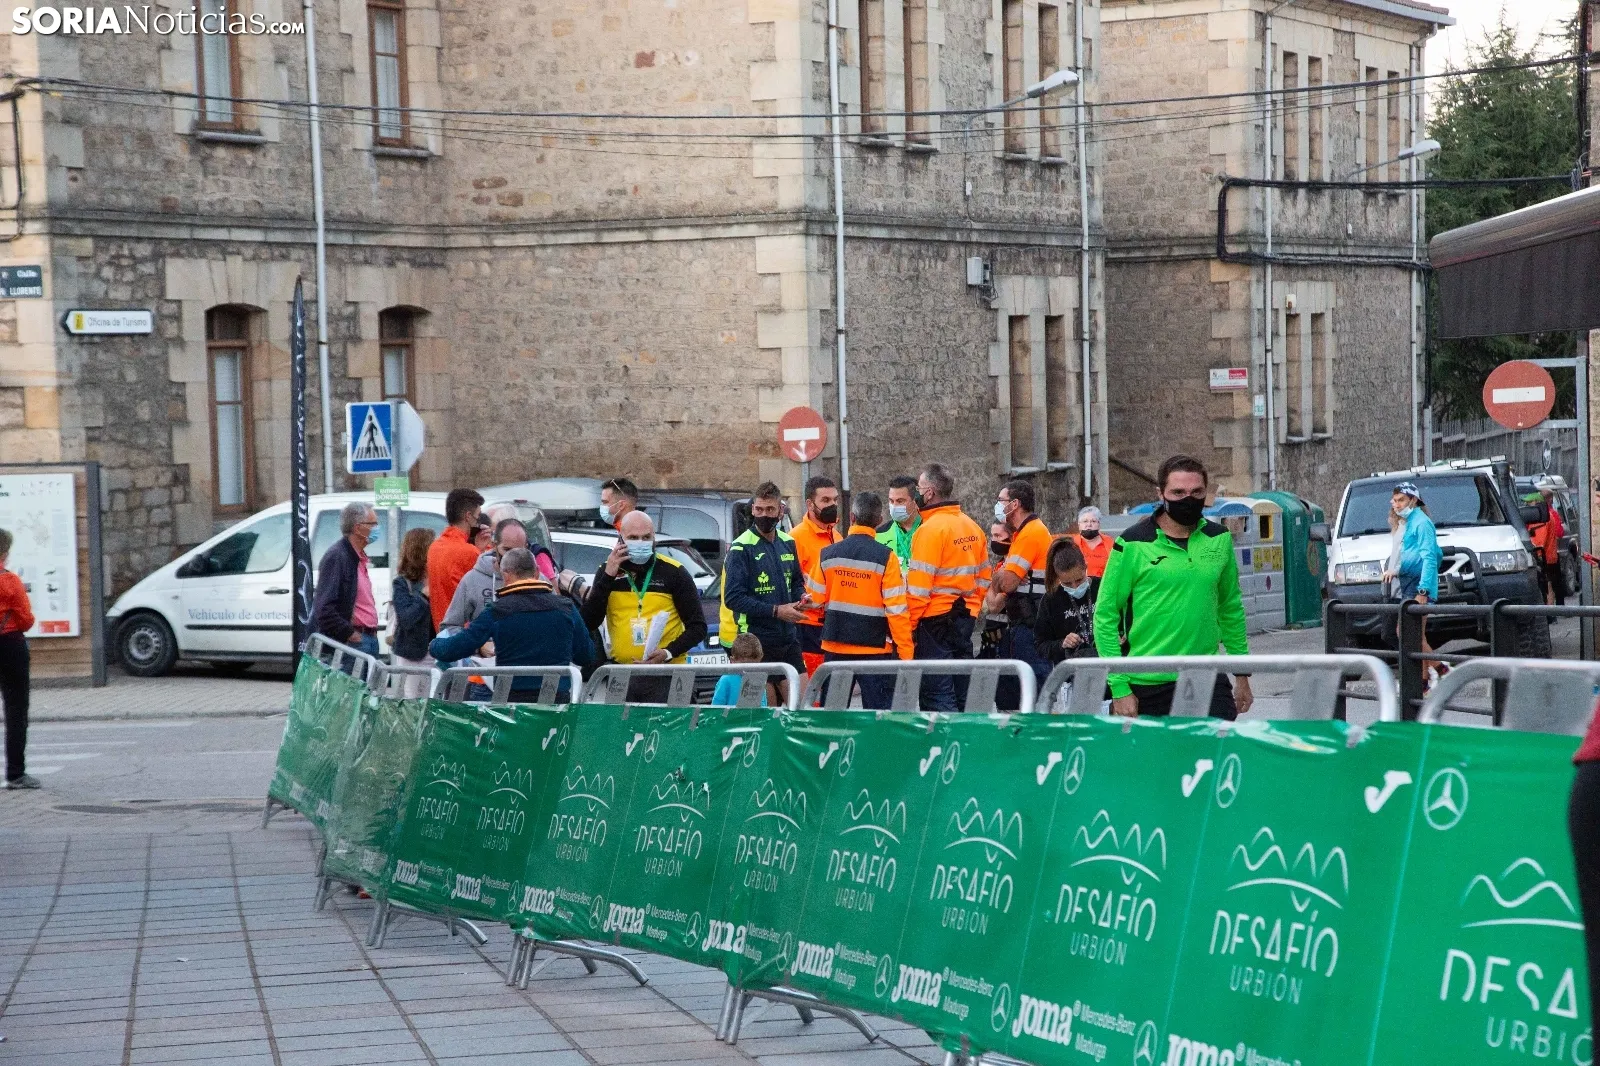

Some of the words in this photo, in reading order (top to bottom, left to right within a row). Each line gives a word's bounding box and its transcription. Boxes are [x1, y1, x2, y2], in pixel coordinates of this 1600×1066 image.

[87, 316, 110, 327] Oficina
[112, 317, 120, 327] de
[122, 316, 147, 328] Turismo
[840, 580, 858, 589] CIVIL
[238, 608, 252, 621] de
[547, 809, 608, 848] DESAFÍO
[635, 820, 703, 860] DESAFÍO
[734, 831, 798, 875] DESAFÍO
[826, 846, 898, 893] DESAFÍO
[392, 859, 419, 885] Joma
[450, 873, 482, 902] Joma
[930, 860, 1014, 914] DESAFÍO
[519, 885, 555, 915] Joma
[834, 887, 875, 913] URBIÓN
[1055, 882, 1157, 942] DESAFÍO
[603, 902, 645, 935] Joma
[650, 905, 688, 923] Mercedes-Benz
[748, 925, 781, 944] Mercedes-Benz
[941, 907, 988, 936] URBIÓN
[790, 941, 834, 979] Joma
[839, 942, 878, 968] Mercedes-Benz
[1069, 933, 1127, 966] URBIÓN
[1208, 909, 1339, 978] DESAFÍO
[892, 964, 942, 1008] Joma
[948, 970, 994, 998] Mercedes-Benz
[1228, 968, 1303, 1005] URBIÓN
[1011, 994, 1073, 1046] Joma
[1079, 1003, 1137, 1036] Mercedes-Benz
